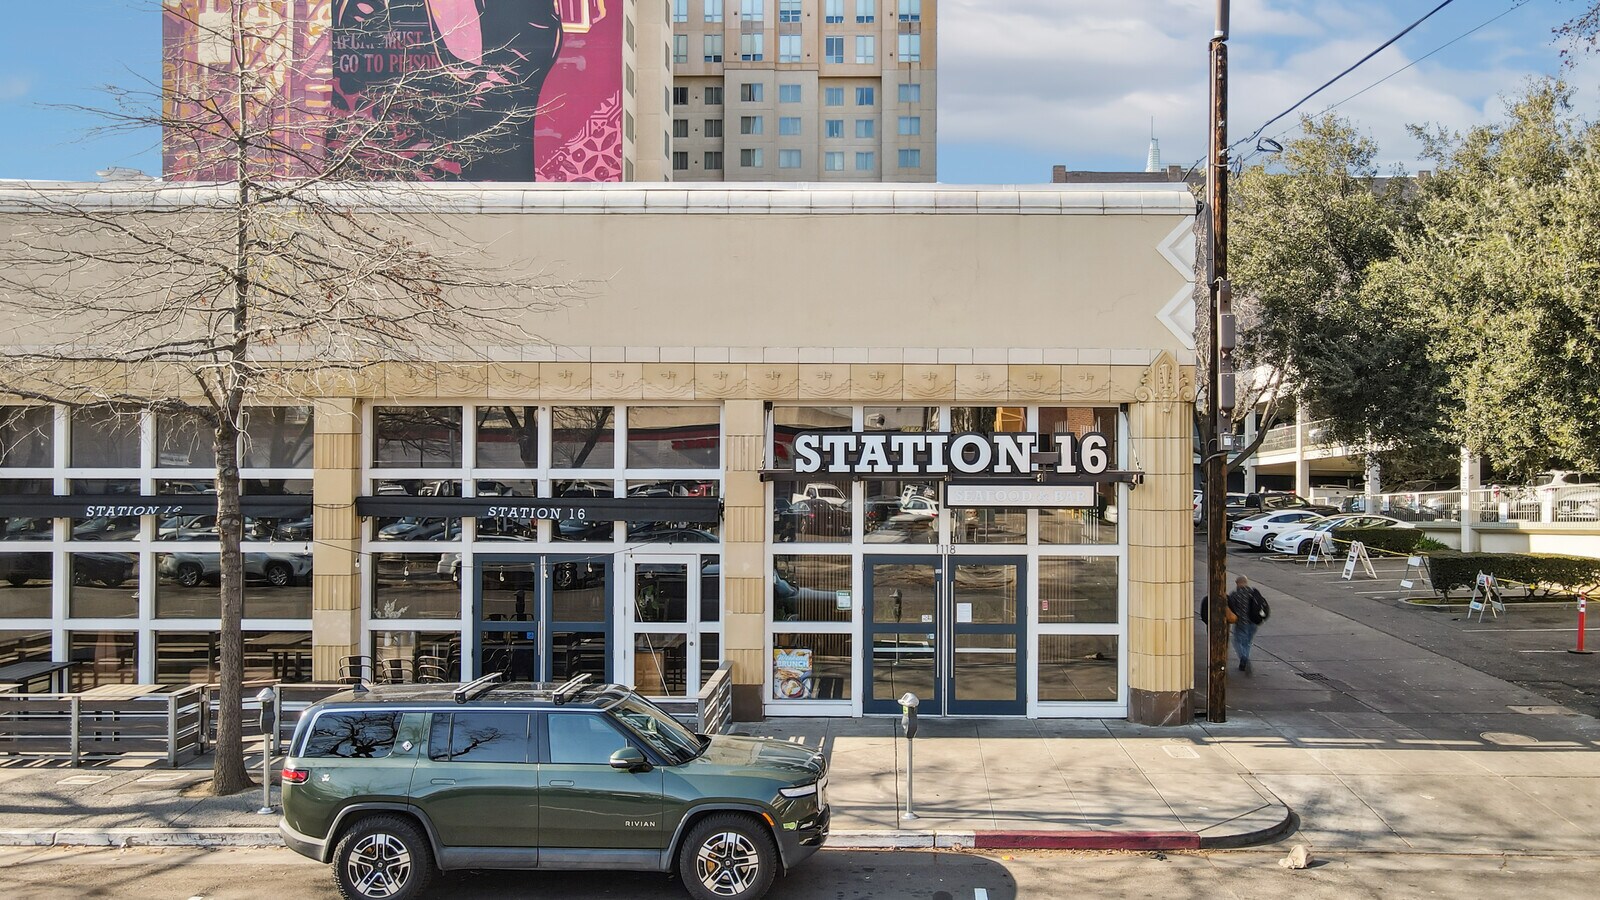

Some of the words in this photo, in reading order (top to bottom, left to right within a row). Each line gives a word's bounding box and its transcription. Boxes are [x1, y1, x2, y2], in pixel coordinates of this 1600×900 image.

[339, 54, 359, 73] GO
[364, 54, 384, 73] TO
[795, 434, 1036, 474] STATION
[1056, 434, 1108, 474] 16
[954, 490, 1032, 502] SEAFOOD
[1038, 490, 1049, 502] &
[1055, 490, 1087, 502] BAR
[86, 505, 160, 517] STATION
[488, 506, 562, 519] STATION
[569, 508, 586, 520] 16
[936, 544, 957, 554] 1118
[777, 660, 809, 668] BRUNCH
